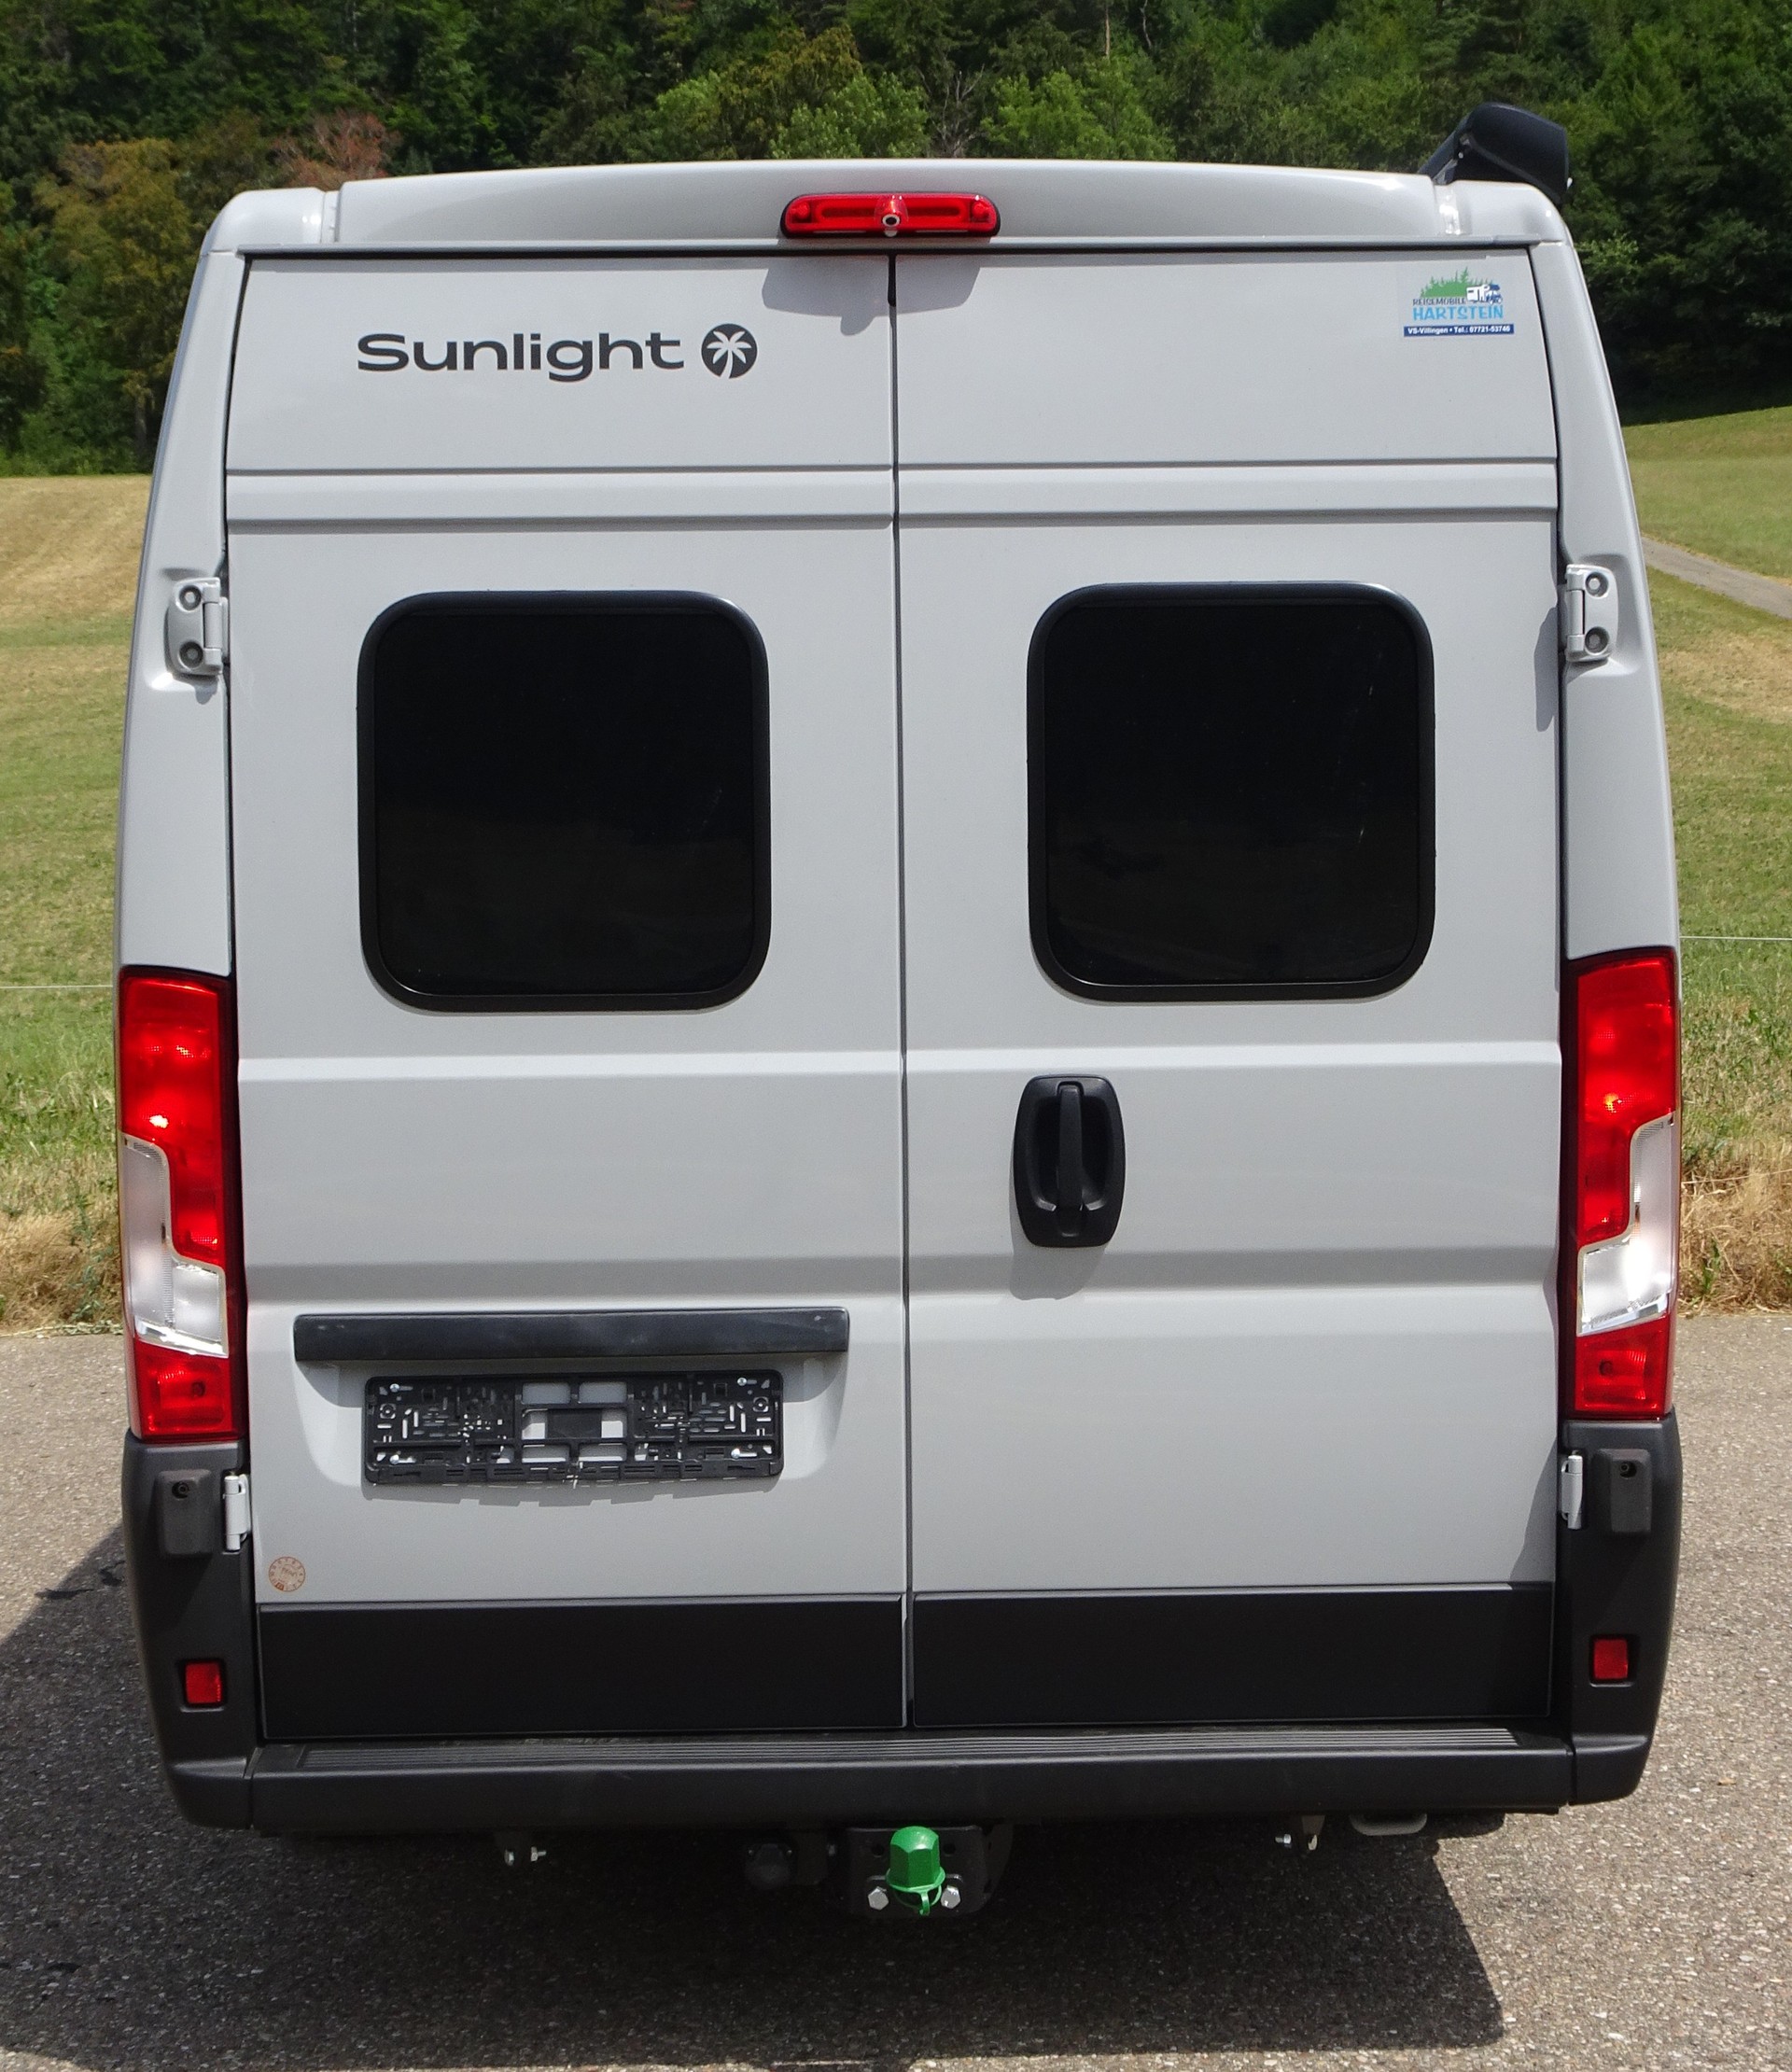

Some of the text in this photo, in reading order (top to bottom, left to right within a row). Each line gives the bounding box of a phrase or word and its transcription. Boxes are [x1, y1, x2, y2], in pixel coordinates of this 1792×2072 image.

[1412, 297, 1466, 306] REISEMOBILE
[1412, 305, 1504, 320] HARTSTEIN
[1407, 327, 1449, 335] VS-Villingen
[357, 332, 684, 383] Sunlight
